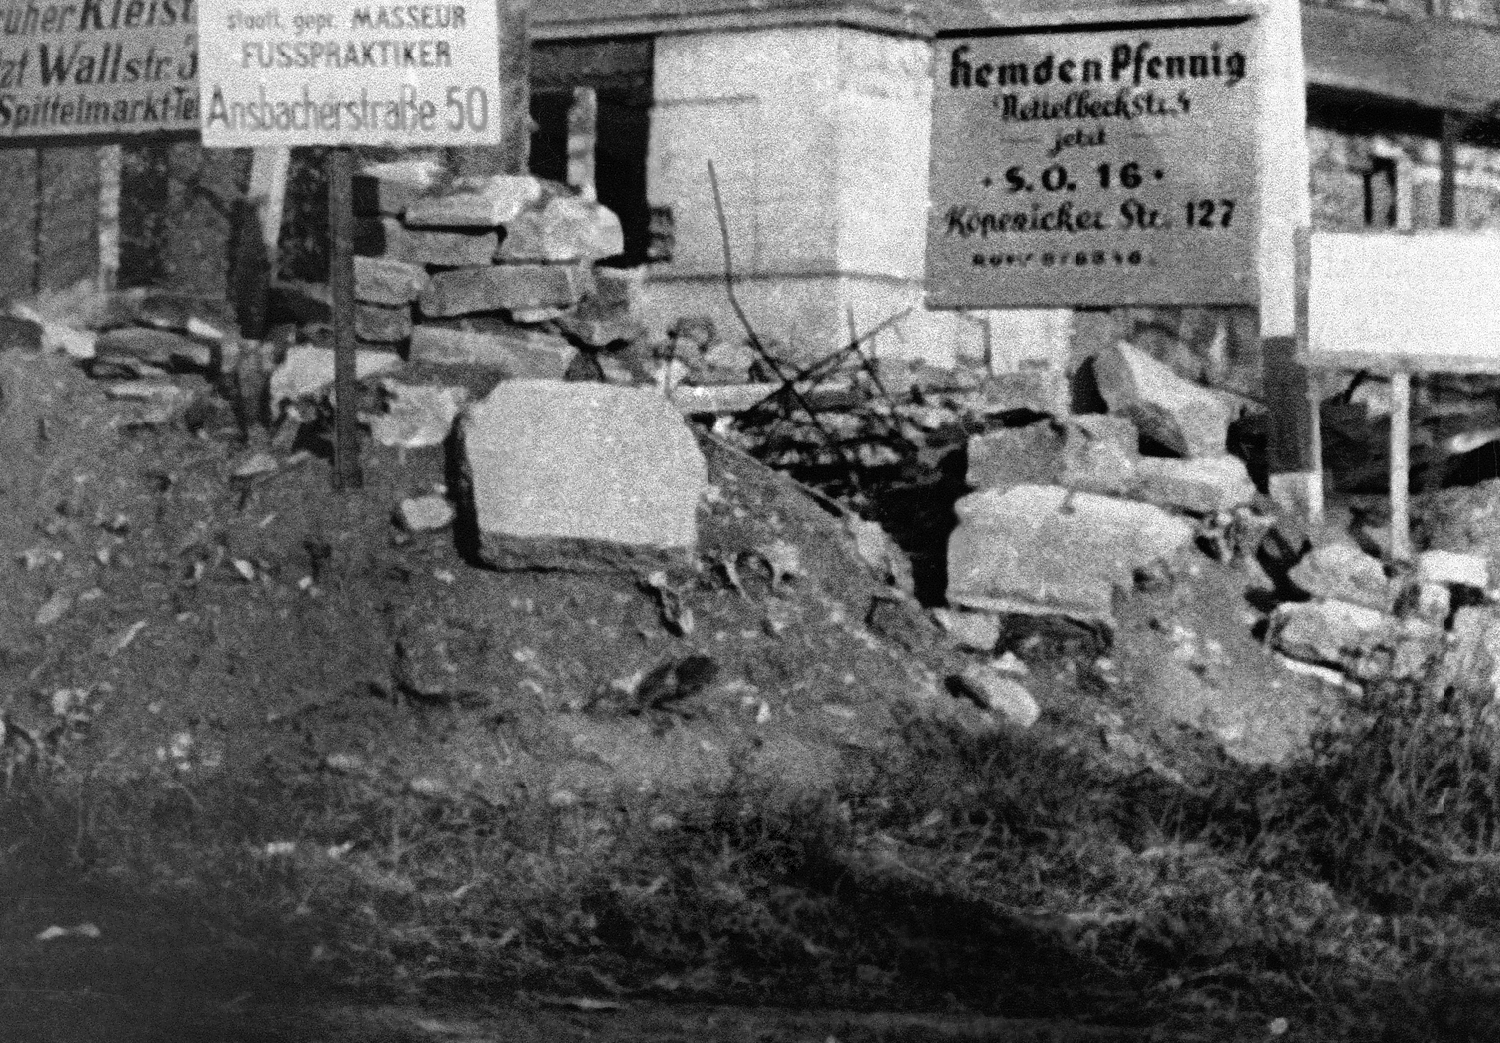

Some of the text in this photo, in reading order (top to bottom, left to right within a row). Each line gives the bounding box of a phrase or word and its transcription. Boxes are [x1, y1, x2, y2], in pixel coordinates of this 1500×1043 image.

[351, 5, 467, 31] MASSEUR
[241, 39, 453, 69] FUSSPRAKTIKER
[207, 83, 489, 134] Ansbacherstraße 50
[1096, 162, 1143, 190] 16
[1184, 198, 1237, 230] 127
